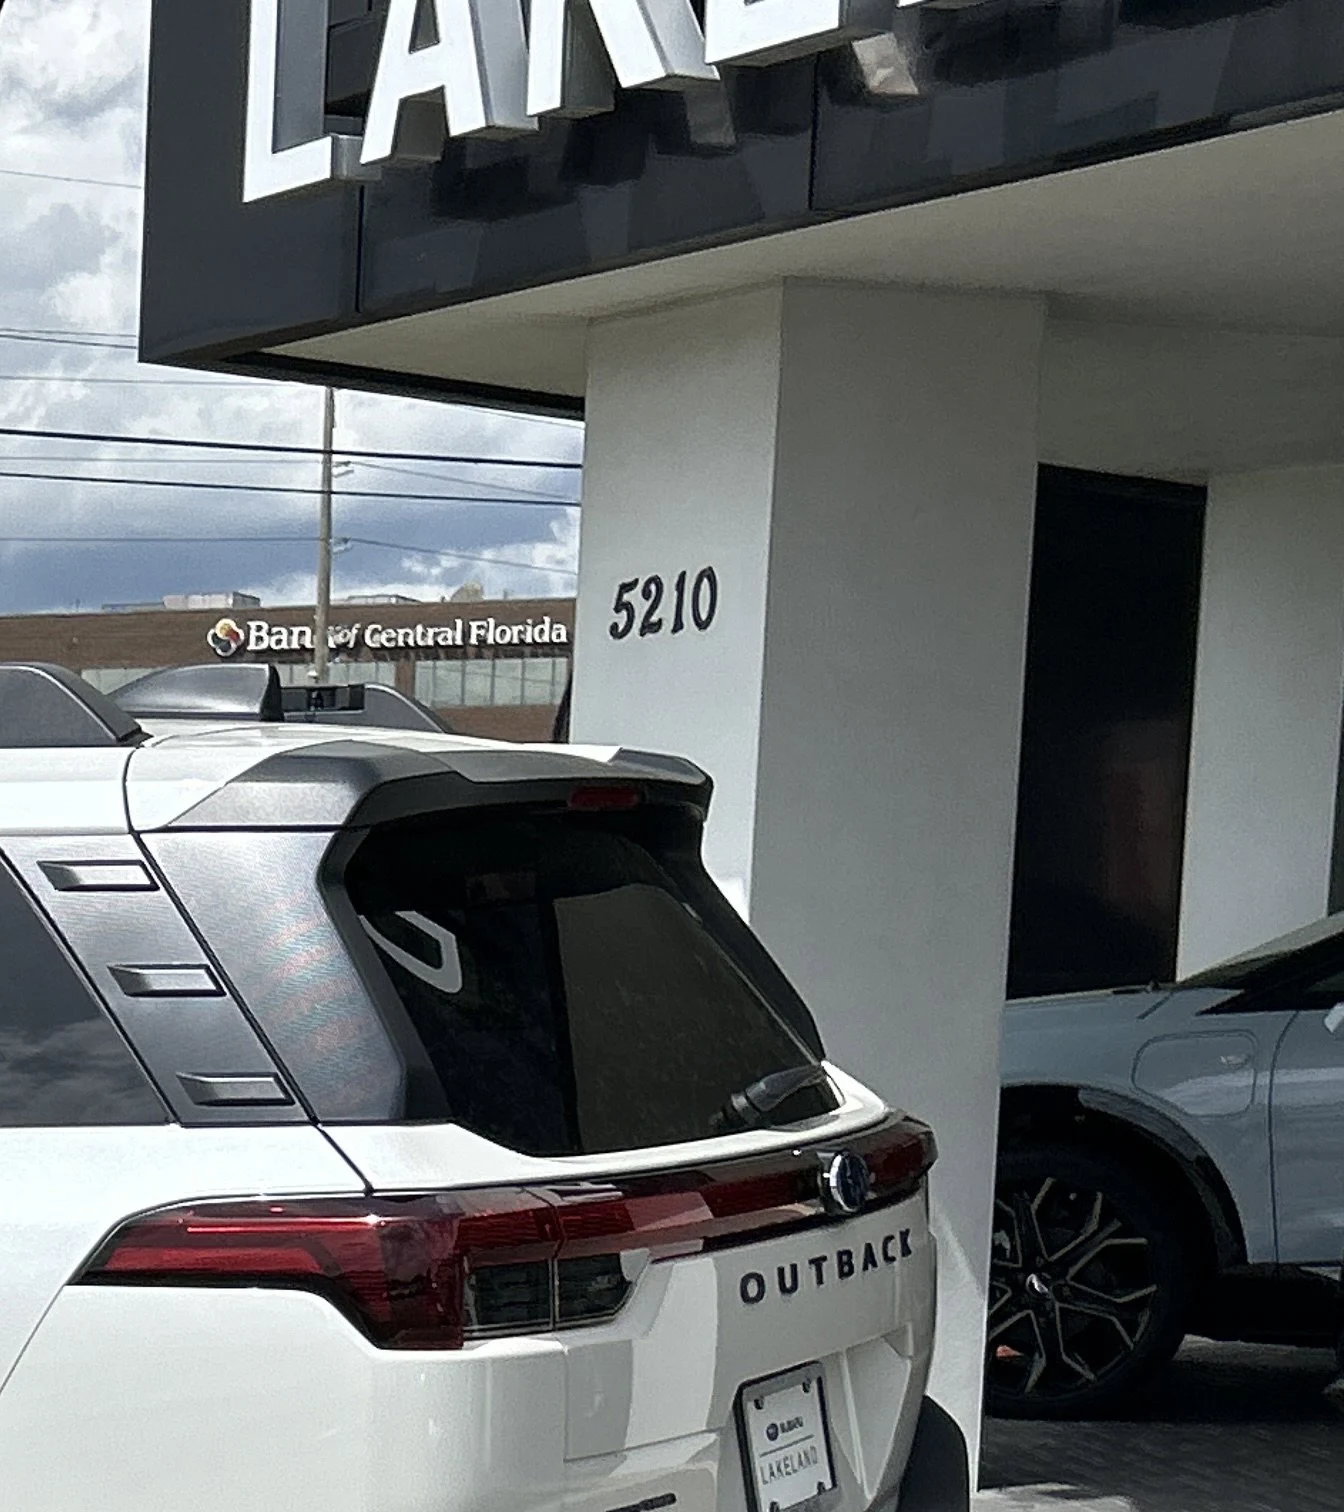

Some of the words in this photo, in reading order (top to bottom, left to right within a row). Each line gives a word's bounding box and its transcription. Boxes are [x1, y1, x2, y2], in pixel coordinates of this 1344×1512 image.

[243, 0, 842, 203] LA
[364, 619, 464, 648] Central
[468, 616, 570, 645] Florida
[609, 565, 718, 640] 5210
[739, 1228, 913, 1305] OUTBACK
[760, 1446, 818, 1485] LAKELAND
